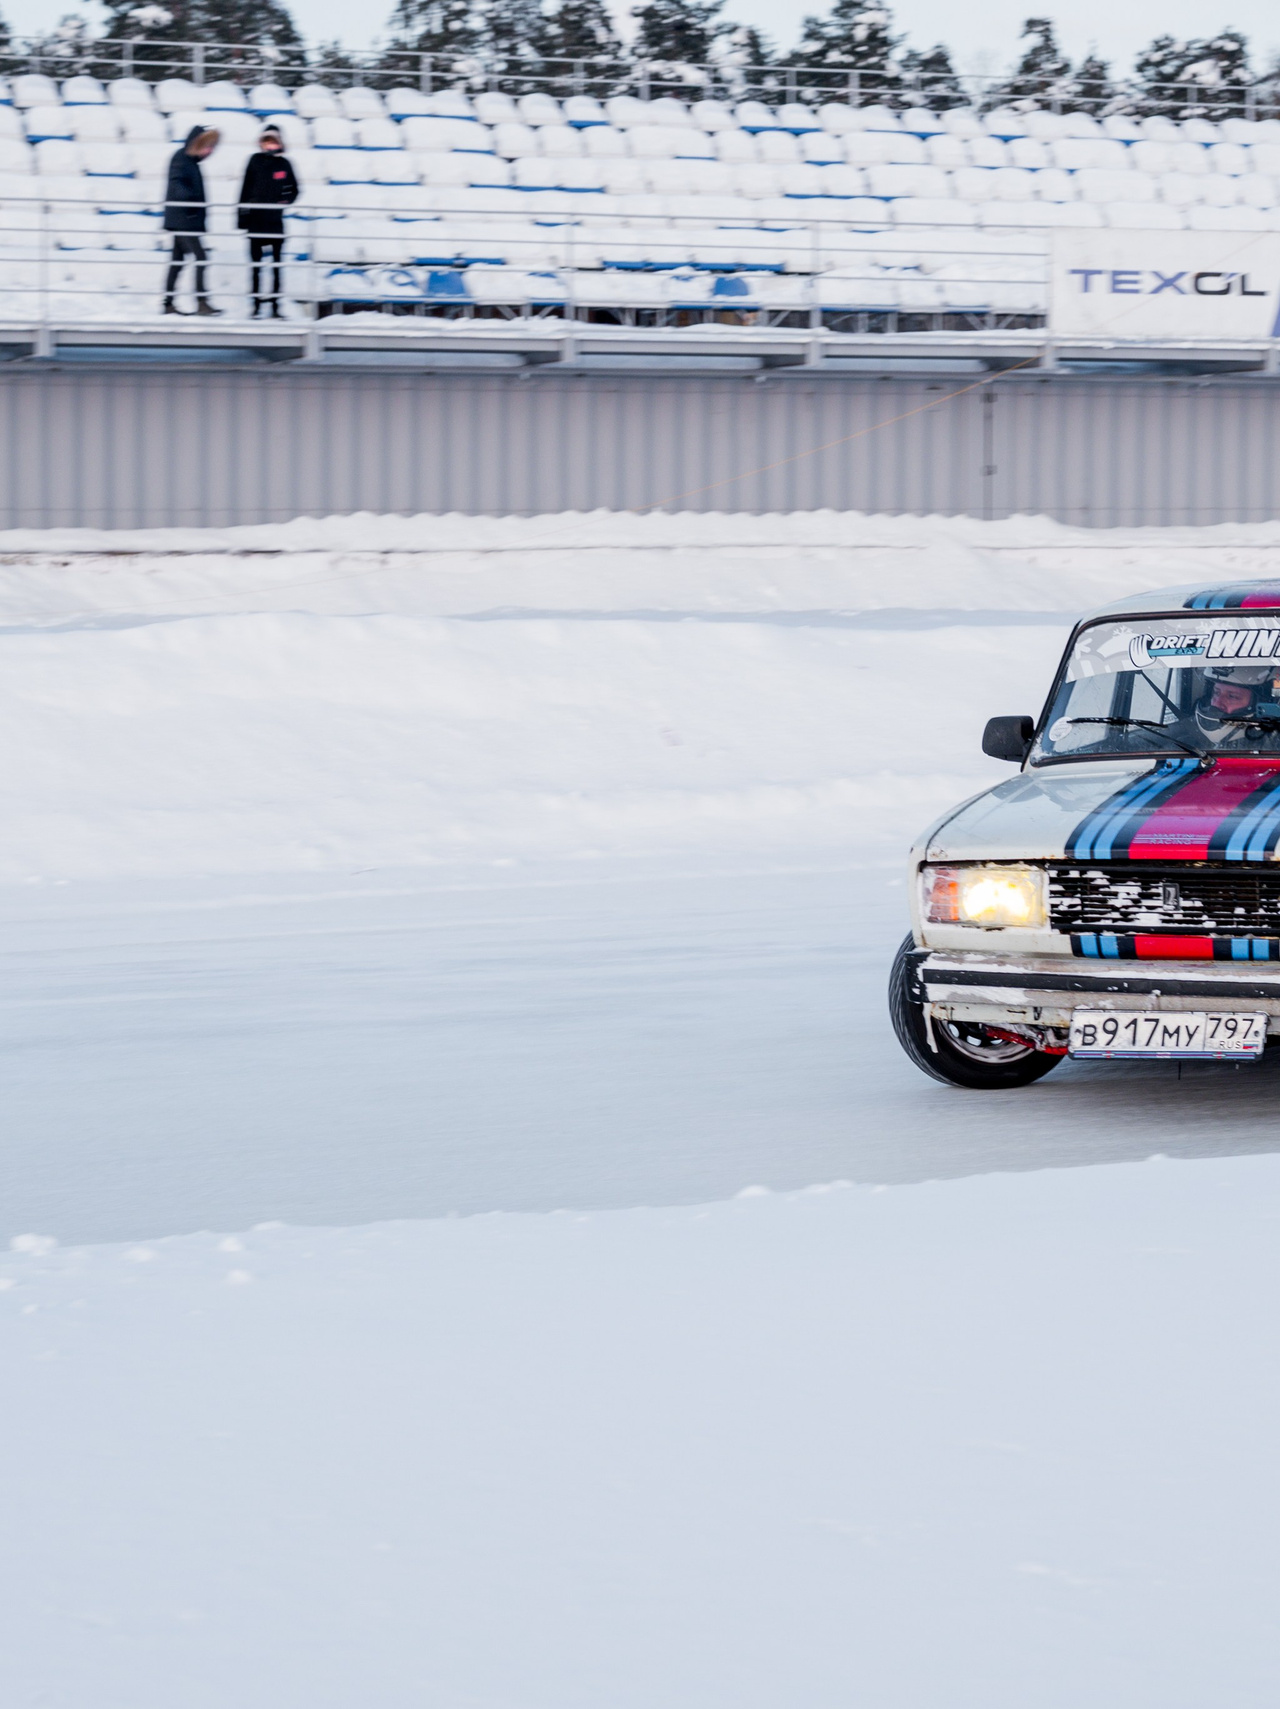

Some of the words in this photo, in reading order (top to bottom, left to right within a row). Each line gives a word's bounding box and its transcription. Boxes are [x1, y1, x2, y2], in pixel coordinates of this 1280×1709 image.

[1067, 269, 1270, 296] TEXOL
[1150, 634, 1210, 650] DRIFT
[1208, 1018, 1255, 1040] 797
[1219, 1040, 1242, 1049] RUS
